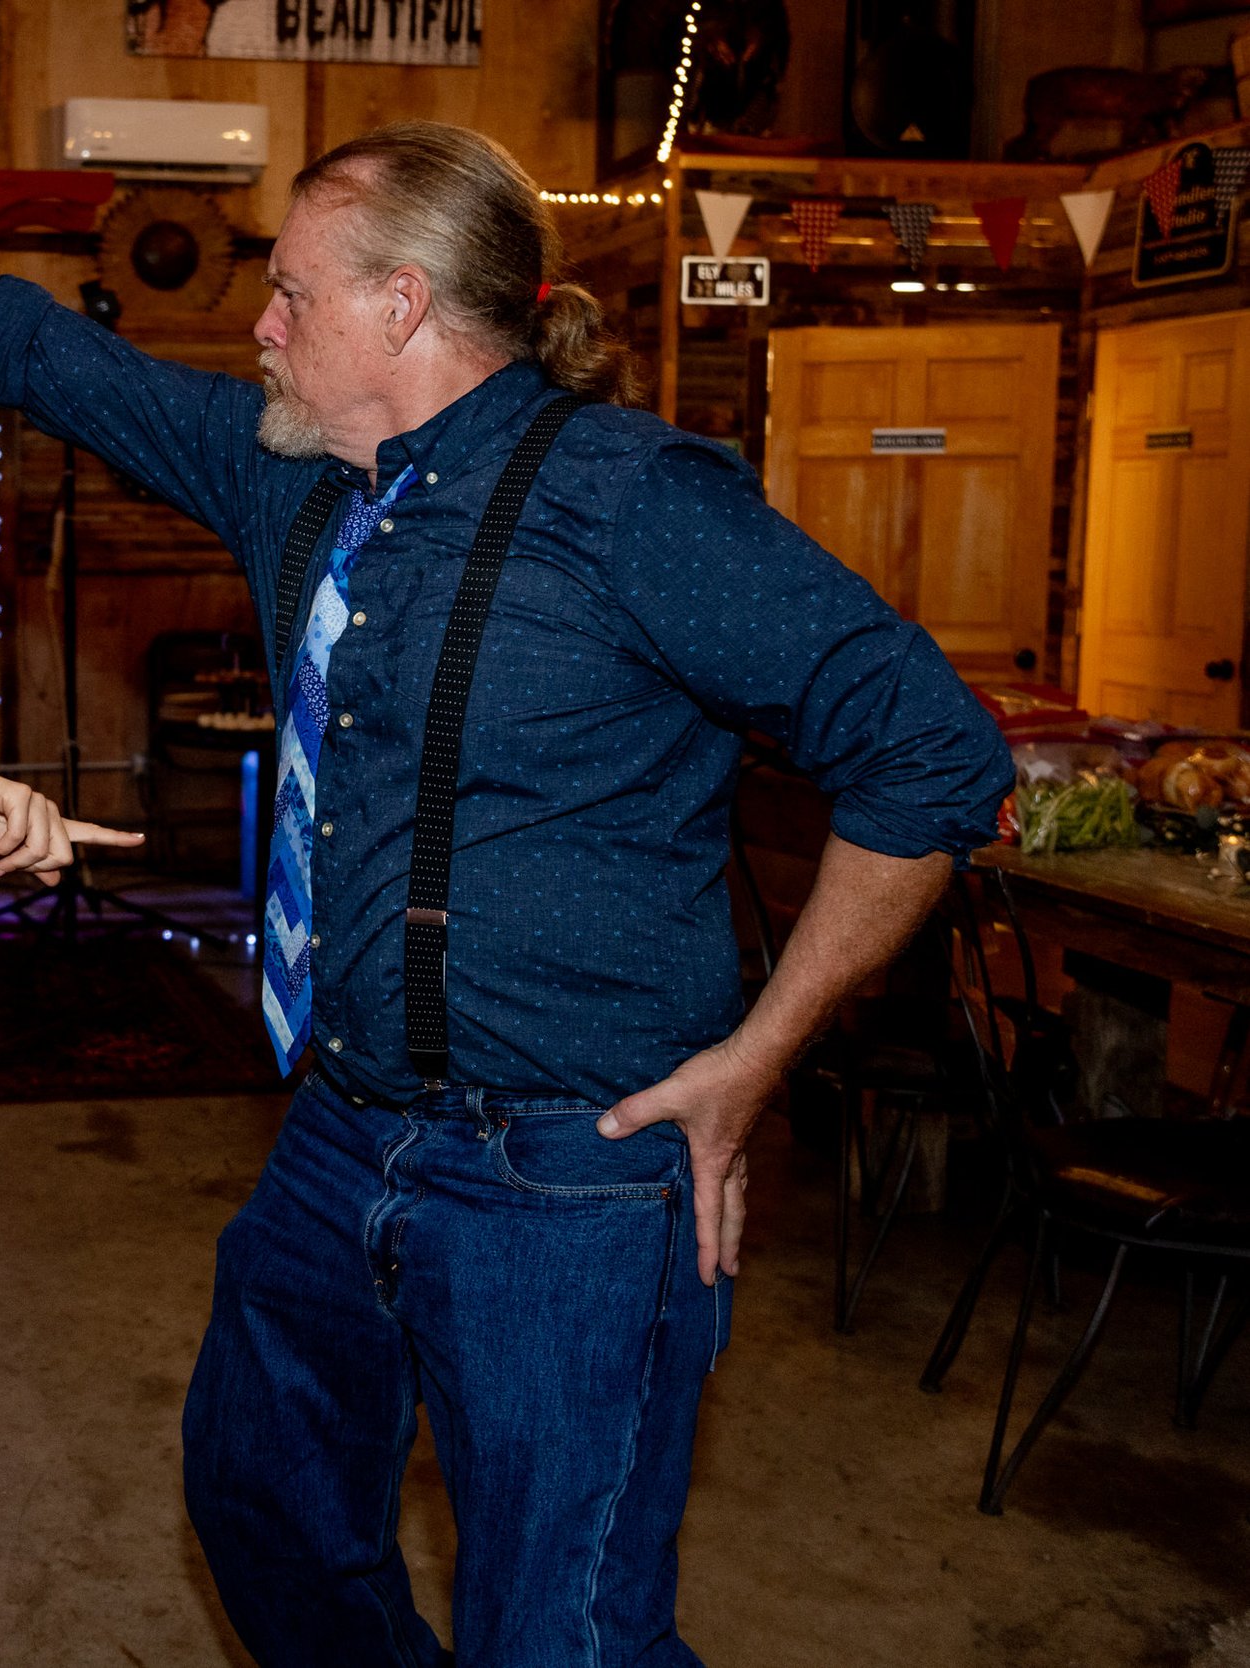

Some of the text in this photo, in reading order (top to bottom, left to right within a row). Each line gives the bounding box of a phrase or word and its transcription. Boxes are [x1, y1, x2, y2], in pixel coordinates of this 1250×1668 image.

[277, 0, 482, 42] BEAUTIFUL
[697, 263, 720, 280] ELY
[715, 280, 755, 298] MILES
